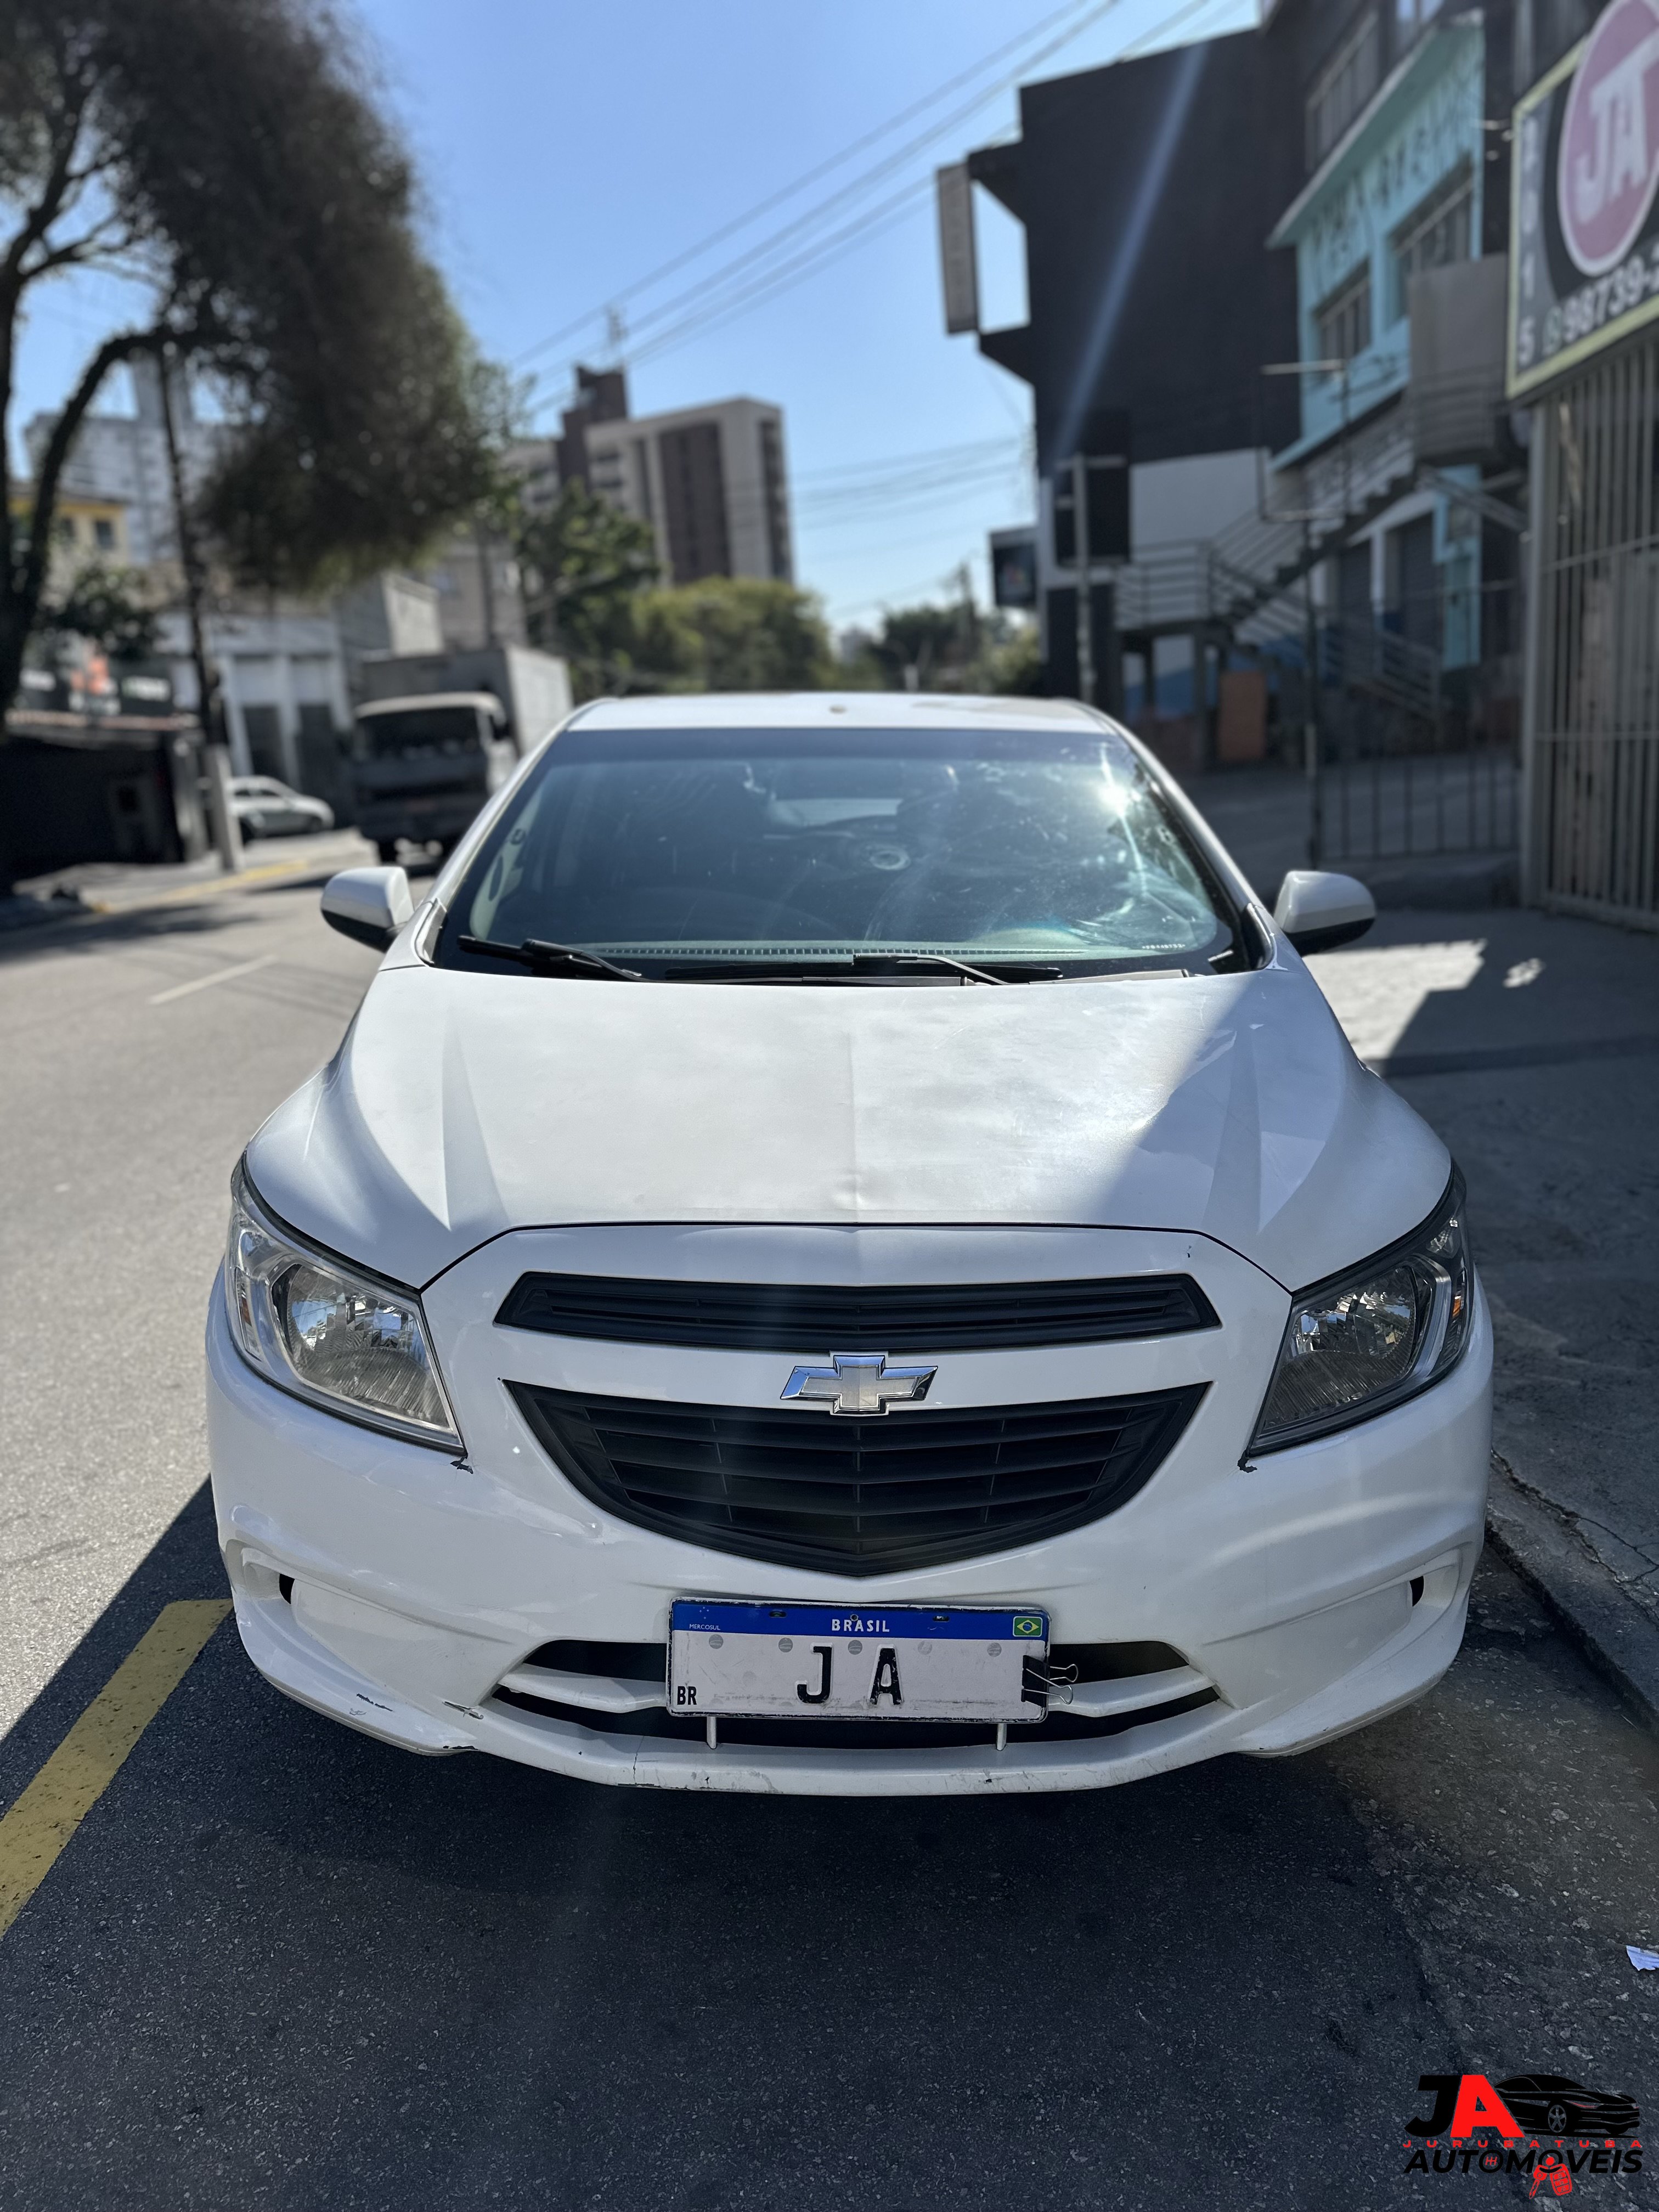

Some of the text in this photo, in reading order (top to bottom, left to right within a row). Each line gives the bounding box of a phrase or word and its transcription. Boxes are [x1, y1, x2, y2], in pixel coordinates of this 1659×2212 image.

[831, 1618, 890, 1633] BRASIL
[797, 1646, 902, 1706] J A
[676, 1685, 697, 1706] BR
